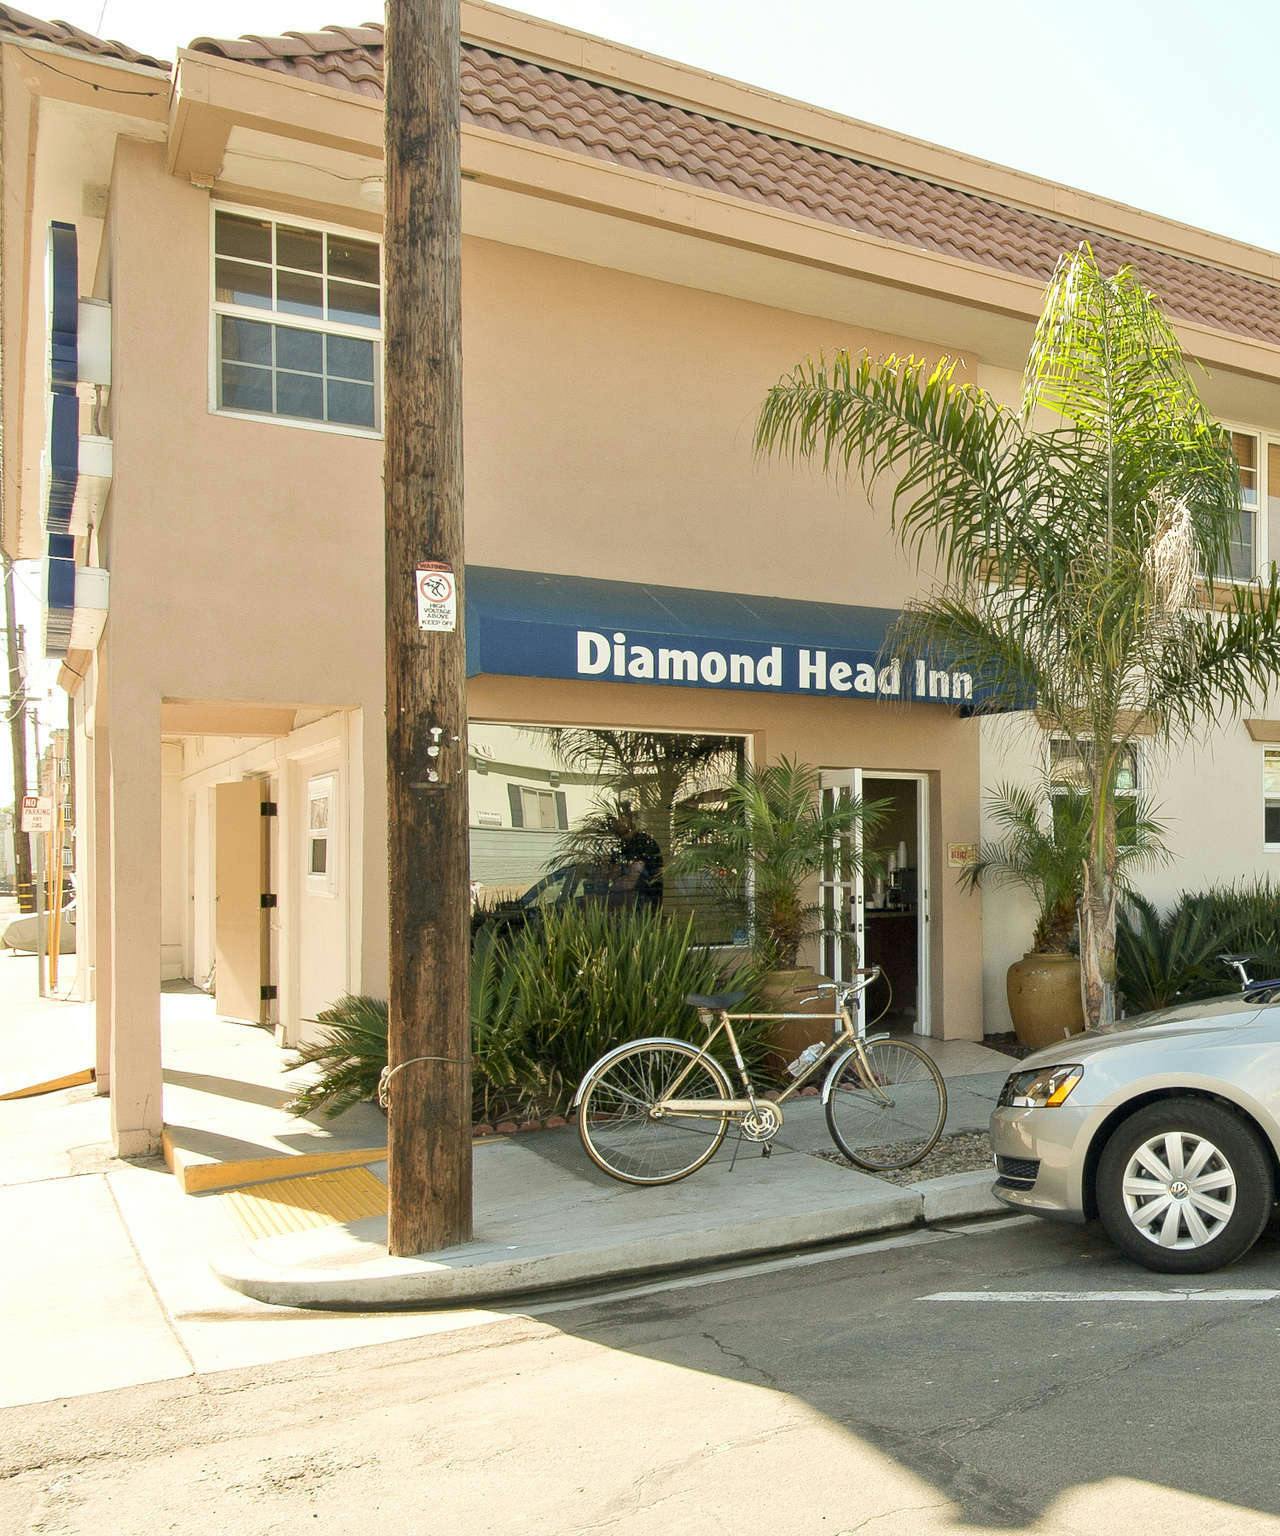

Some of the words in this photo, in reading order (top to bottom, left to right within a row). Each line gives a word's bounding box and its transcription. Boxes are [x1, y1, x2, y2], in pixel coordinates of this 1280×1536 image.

[577, 630, 783, 687] Diamond
[799, 649, 901, 695] Head
[915, 659, 973, 699] Inn
[25, 798, 36, 807] NO
